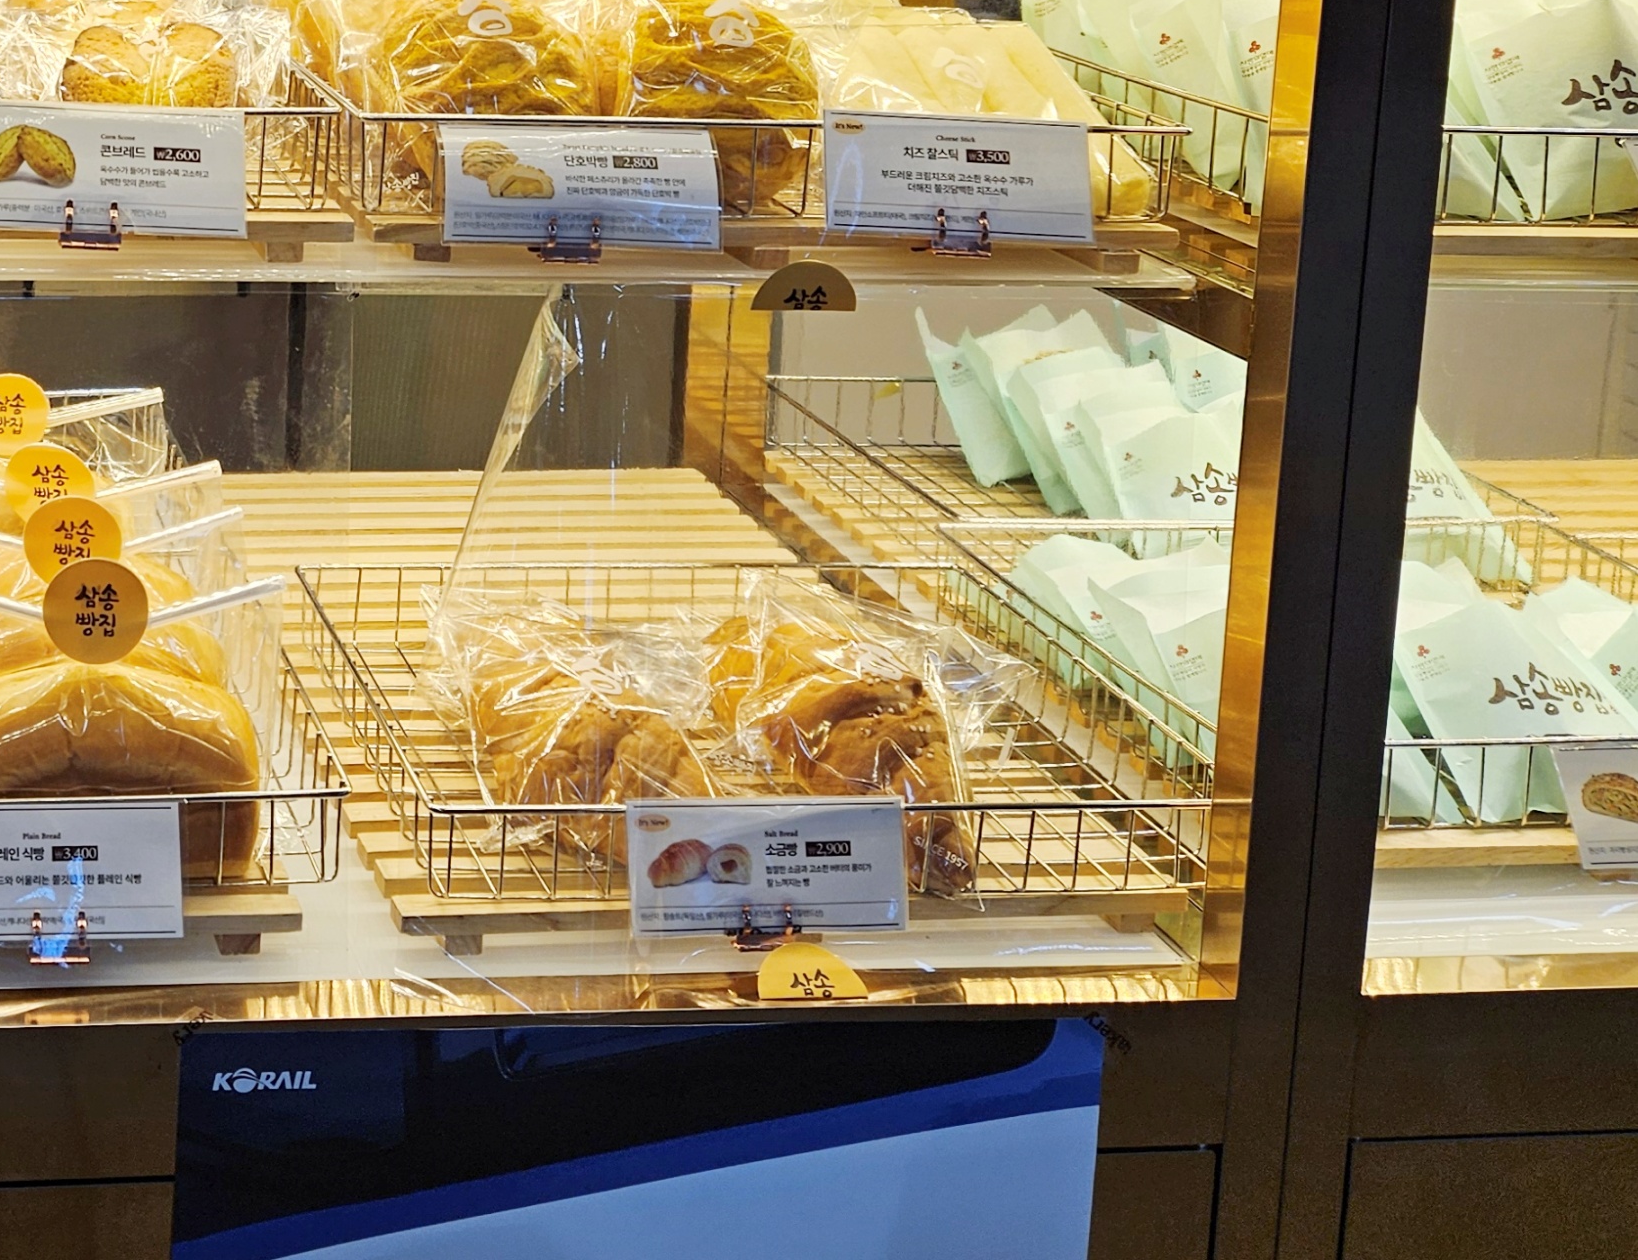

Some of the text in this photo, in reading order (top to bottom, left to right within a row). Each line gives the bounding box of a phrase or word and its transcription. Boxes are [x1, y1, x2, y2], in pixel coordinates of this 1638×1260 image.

[835, 122, 846, 130] It's
[100, 145, 200, 161] 콘브레드 ₩2,600
[564, 154, 608, 168] 단호박빵
[904, 146, 926, 160] 치즈
[927, 148, 959, 162] 찰스틱
[100, 166, 209, 178] 옥수수가 고소하고
[881, 170, 1034, 186] 부드러운 크림치즈와 고소한 옥수수 가루가
[908, 183, 1008, 196] 더해진 치즈스틱
[783, 284, 828, 310] 삼송
[31, 463, 69, 488] 삼송
[1170, 462, 1238, 506] 삼송
[54, 519, 95, 544] 삼송
[74, 581, 120, 611] 삼송
[74, 609, 118, 639] 빵집
[22, 832, 61, 840] Plain Bread
[22, 847, 45, 861] 식빵
[765, 843, 798, 857] 소금빵
[945, 850, 969, 871] 1957
[16, 875, 50, 886] 어울리는
[97, 874, 122, 885] 플레인
[125, 873, 142, 885] 식빵
[790, 968, 835, 998] 삼송
[212, 1067, 317, 1094] KORAIL
